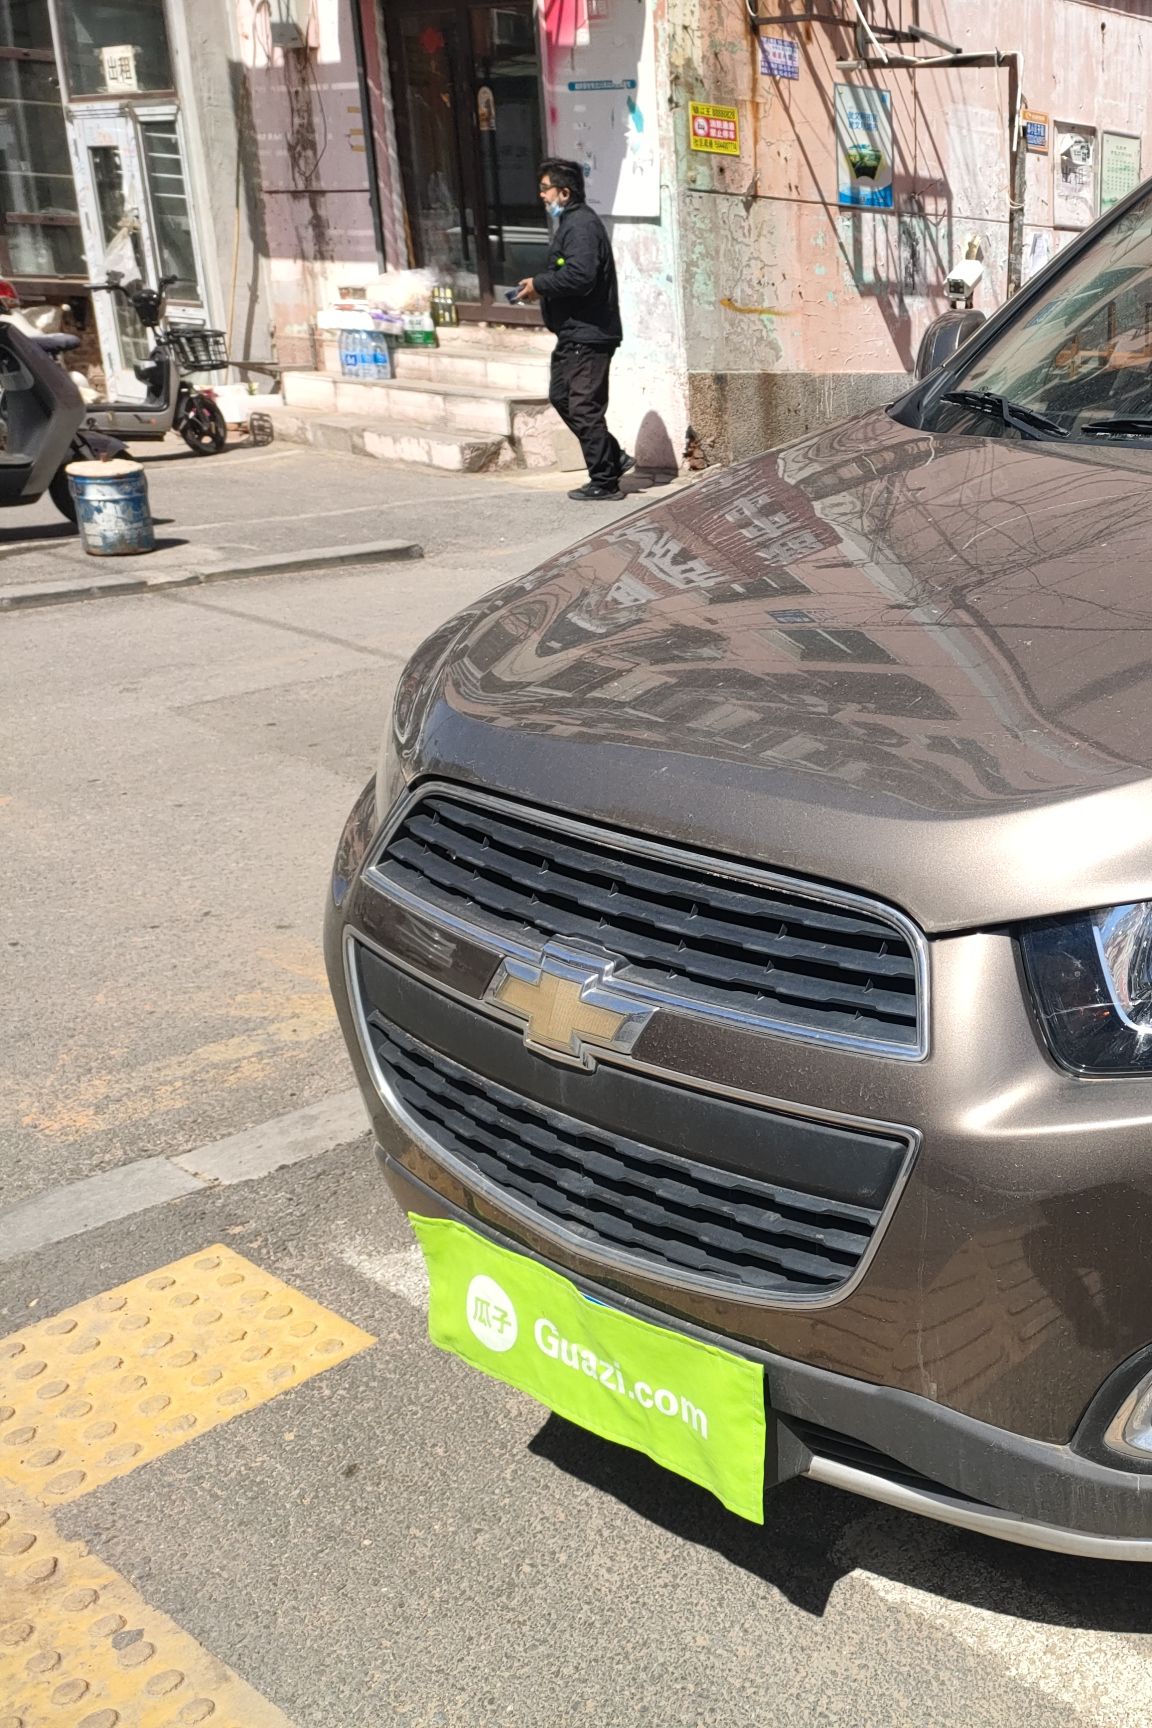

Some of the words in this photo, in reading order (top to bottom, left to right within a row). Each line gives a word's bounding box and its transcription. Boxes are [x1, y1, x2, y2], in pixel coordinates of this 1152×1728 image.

[107, 56, 132, 82] 出租
[473, 1295, 512, 1334] 瓜子
[533, 1317, 708, 1440] Guazi.com
